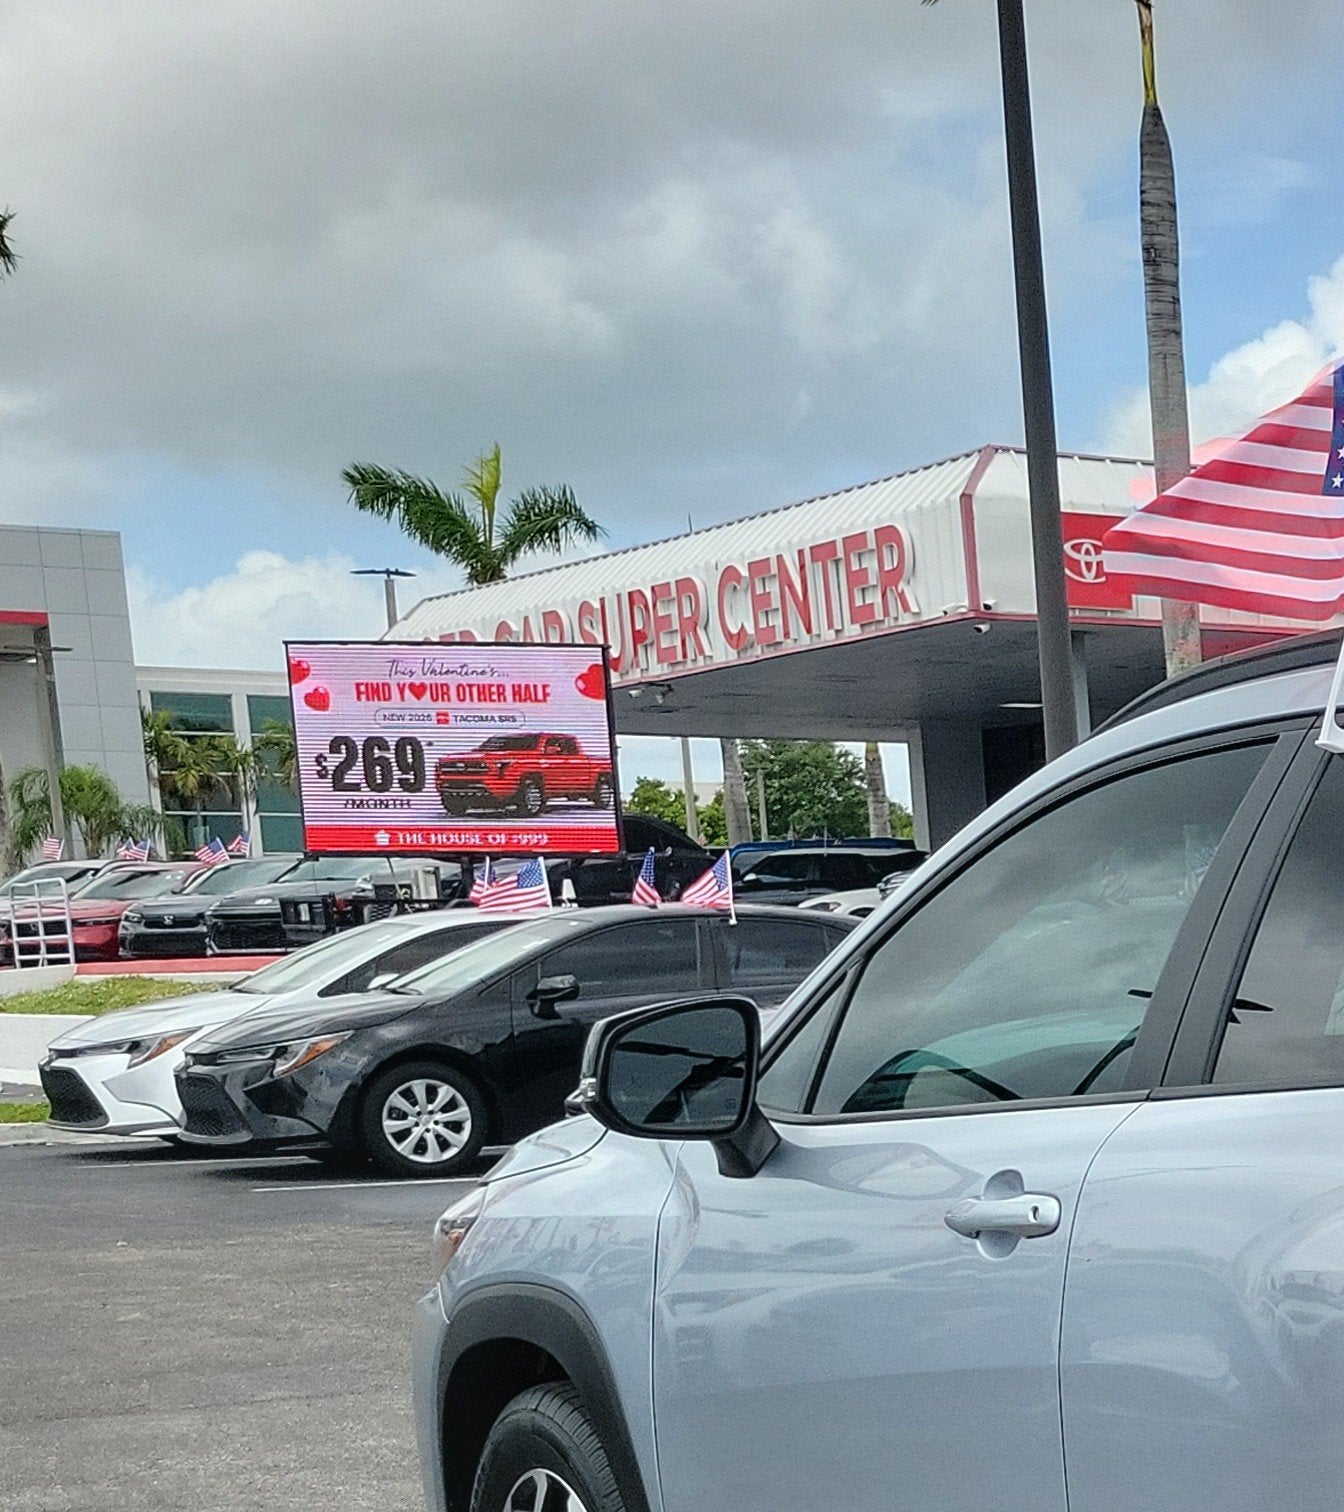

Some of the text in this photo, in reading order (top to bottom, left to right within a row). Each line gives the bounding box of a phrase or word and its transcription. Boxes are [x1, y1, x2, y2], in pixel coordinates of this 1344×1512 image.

[578, 524, 916, 674] SUPER CENTER
[386, 659, 417, 678] This
[355, 682, 392, 702] FIND
[456, 683, 507, 702] OTHER
[511, 684, 551, 703] HALF
[382, 713, 406, 722] NEW
[452, 714, 497, 723] TACOMA
[398, 832, 427, 845] THE
[430, 833, 484, 845] HOUSE
